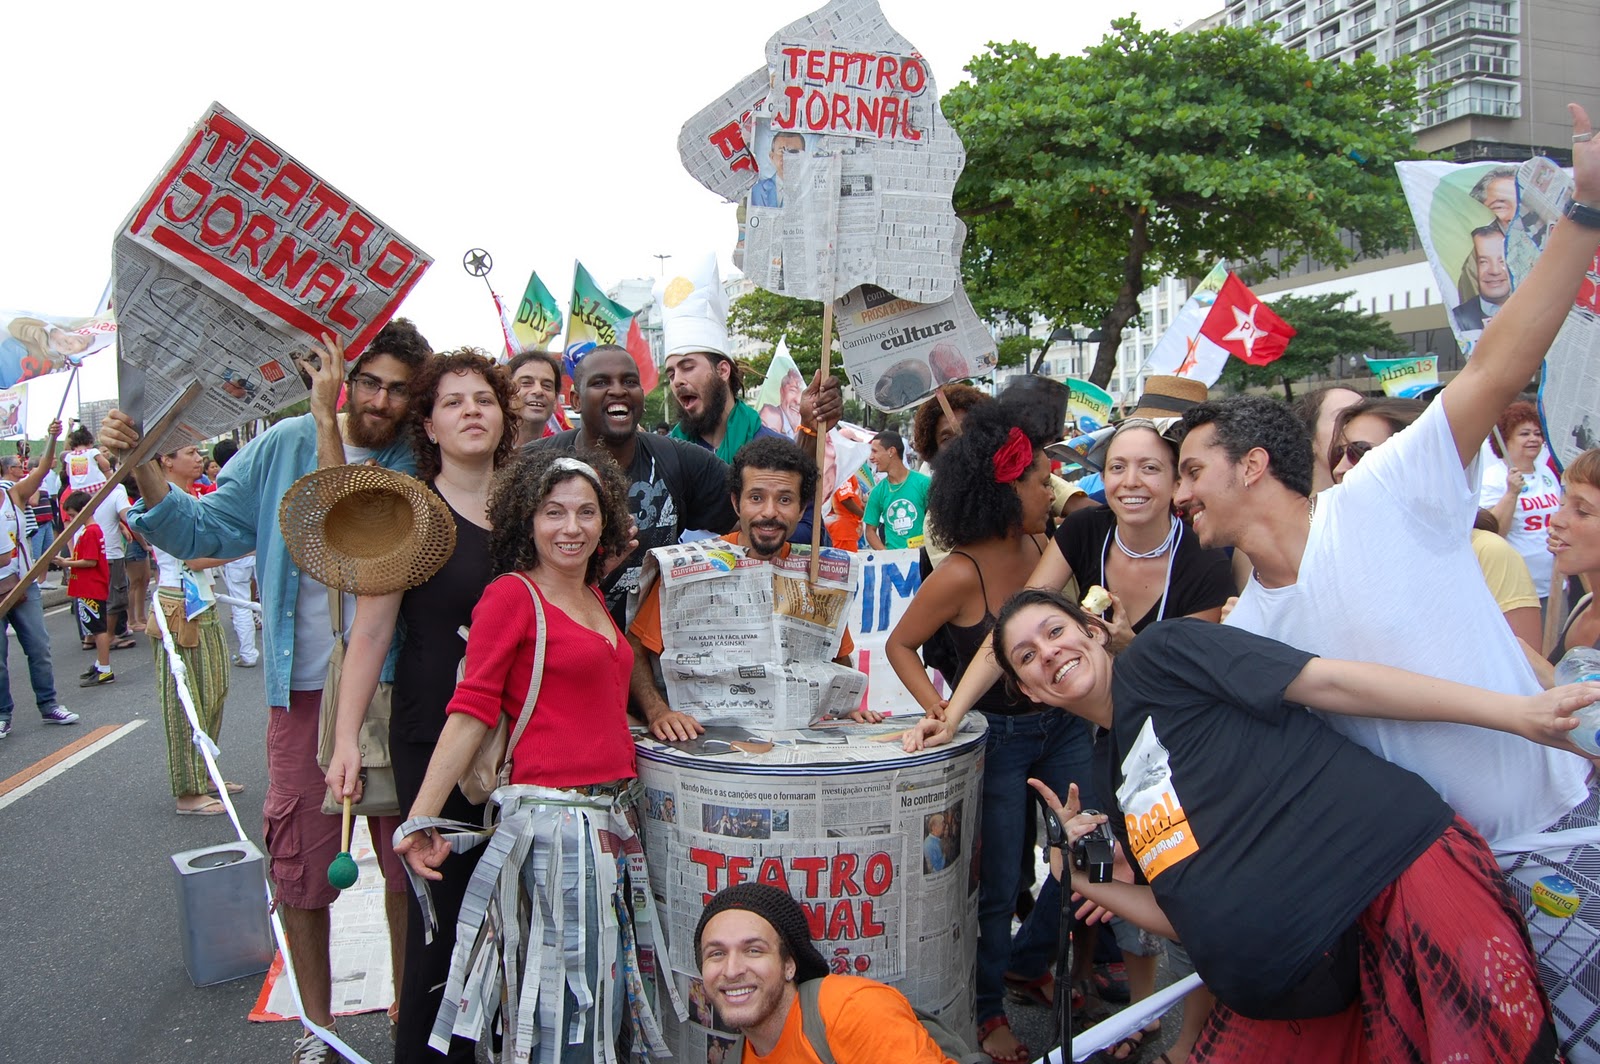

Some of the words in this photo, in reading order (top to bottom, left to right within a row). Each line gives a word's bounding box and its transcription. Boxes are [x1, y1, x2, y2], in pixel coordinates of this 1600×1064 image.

[781, 48, 925, 93] TEATRO
[771, 86, 921, 141] JORNAL
[203, 112, 414, 289] TEATRO
[163, 171, 359, 331] JORNAL
[861, 306, 889, 323] PROSA
[896, 301, 919, 312] VERS
[842, 329, 887, 350] Caminhos
[888, 326, 900, 336] da
[880, 319, 957, 351] cultura
[1520, 493, 1560, 512] DILM
[681, 781, 700, 793] Nando
[700, 786, 713, 796] Reis
[728, 790, 757, 801] canções
[758, 793, 772, 801] que
[779, 792, 816, 801] formaram
[822, 785, 863, 796] nvestigação
[863, 783, 891, 793] criminal
[901, 796, 912, 808] Na
[690, 847, 893, 898] TEATRO
[1534, 886, 1574, 910] Dilma13
